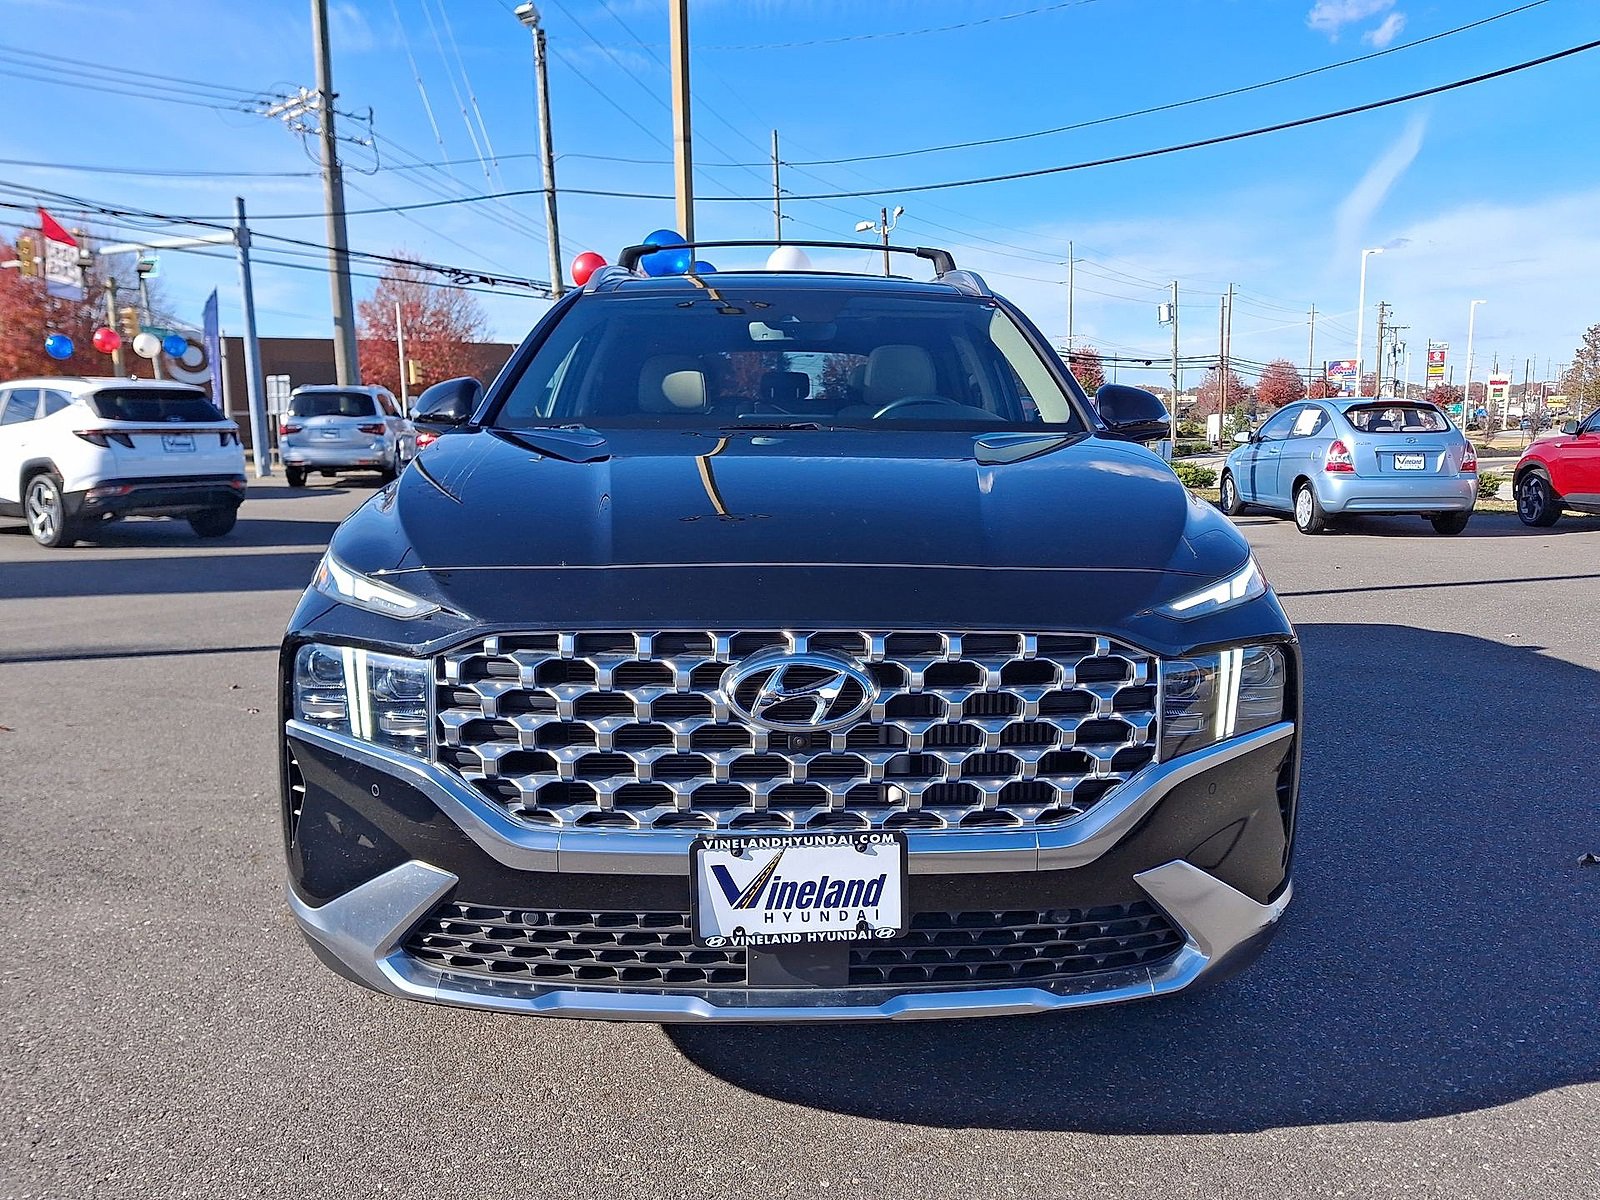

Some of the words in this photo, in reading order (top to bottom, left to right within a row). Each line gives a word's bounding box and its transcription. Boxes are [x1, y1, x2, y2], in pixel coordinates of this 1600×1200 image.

[702, 833, 895, 850] VINELANDHYUNDAI.COM
[710, 846, 887, 910] Vineland
[763, 909, 880, 924] HYUNDAI
[730, 931, 802, 946] VINELAND
[807, 928, 872, 943] HYUNDAI
